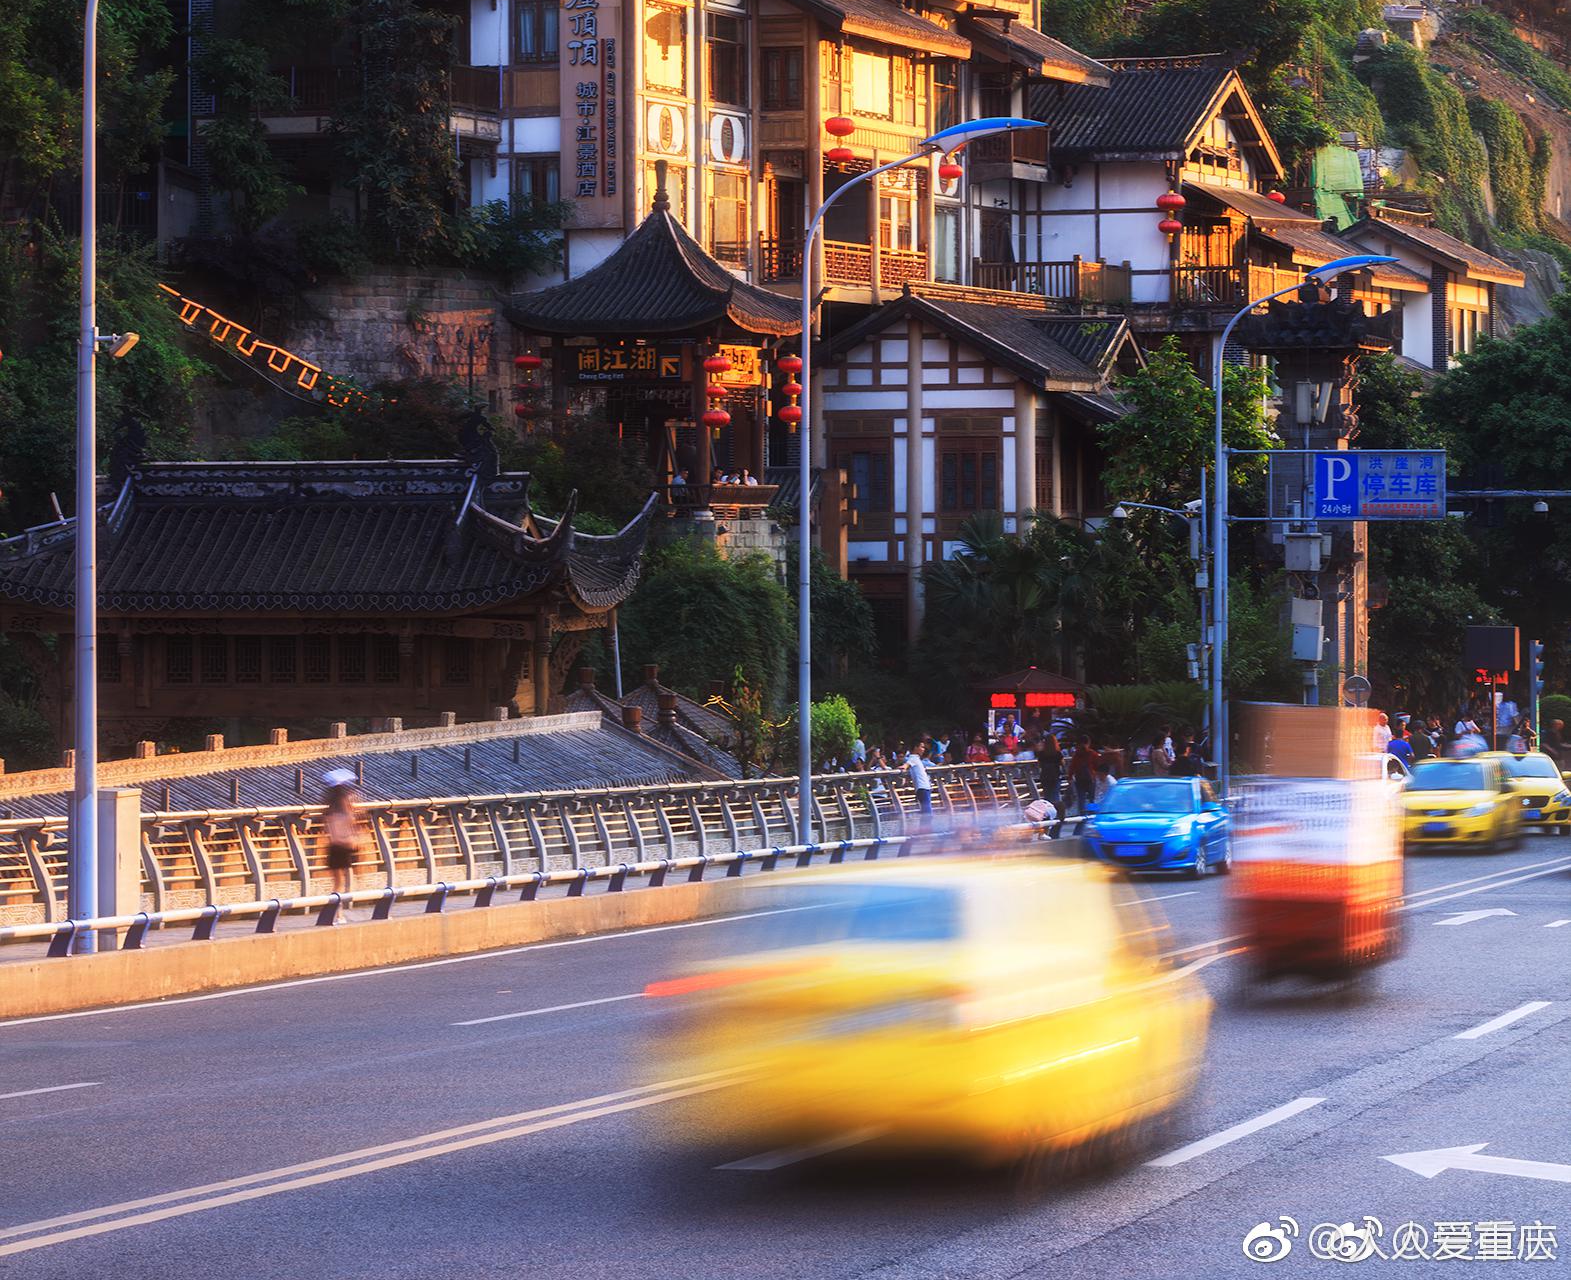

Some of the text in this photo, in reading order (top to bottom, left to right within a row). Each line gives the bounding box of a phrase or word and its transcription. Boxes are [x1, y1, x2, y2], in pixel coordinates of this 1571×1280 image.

[605, 38, 616, 197] ROOF CITY RIVERVIEW HOTEL
[578, 347, 656, 371] 闹江湖
[1368, 455, 1433, 470] 洪崖洞
[1322, 457, 1351, 500] P
[1362, 472, 1438, 496] 停车库
[1321, 504, 1352, 514] 24小时
